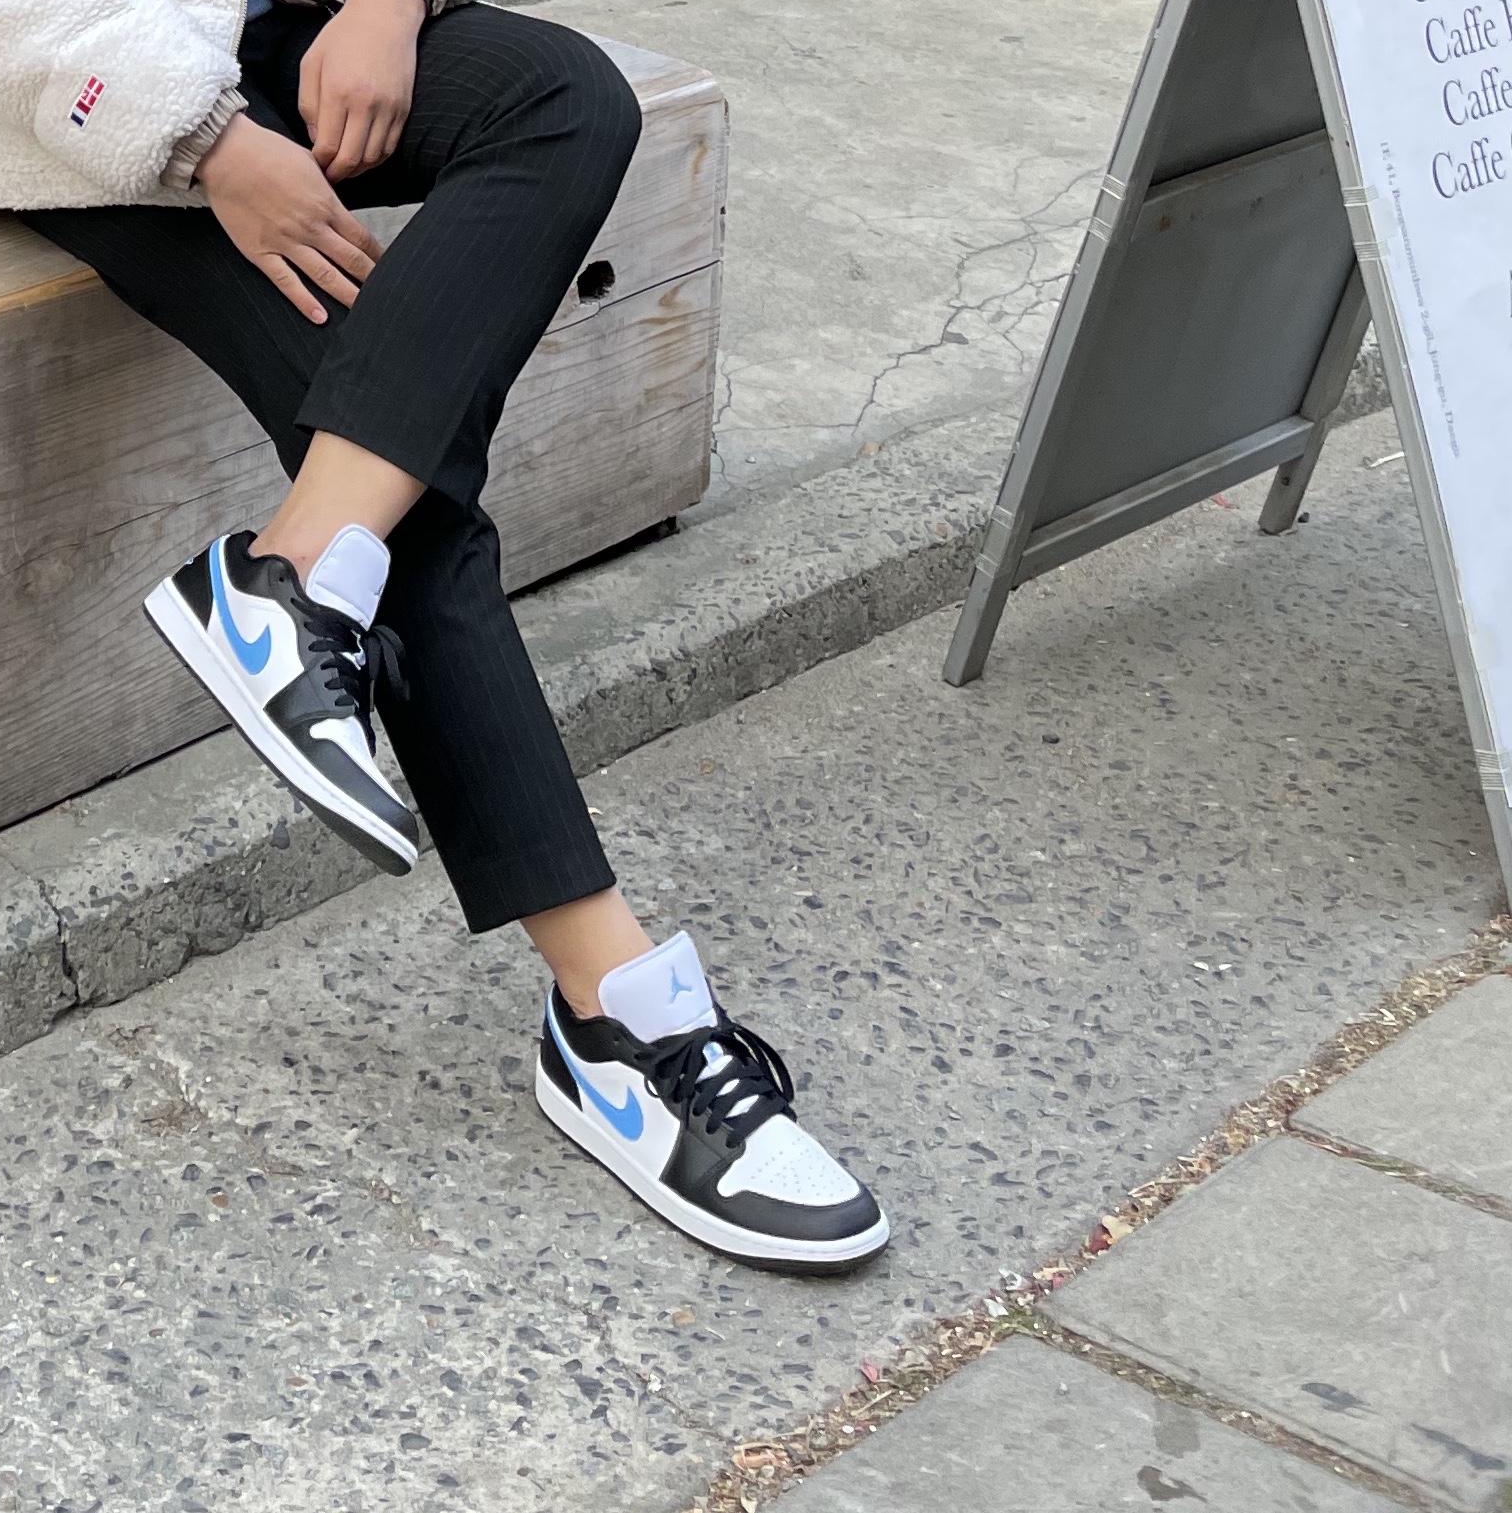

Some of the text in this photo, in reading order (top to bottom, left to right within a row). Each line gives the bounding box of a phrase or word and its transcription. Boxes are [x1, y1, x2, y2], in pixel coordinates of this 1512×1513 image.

[1425, 5, 1499, 64] Caffe
[1442, 66, 1512, 126] Caffe
[1431, 136, 1507, 199] Caffe
